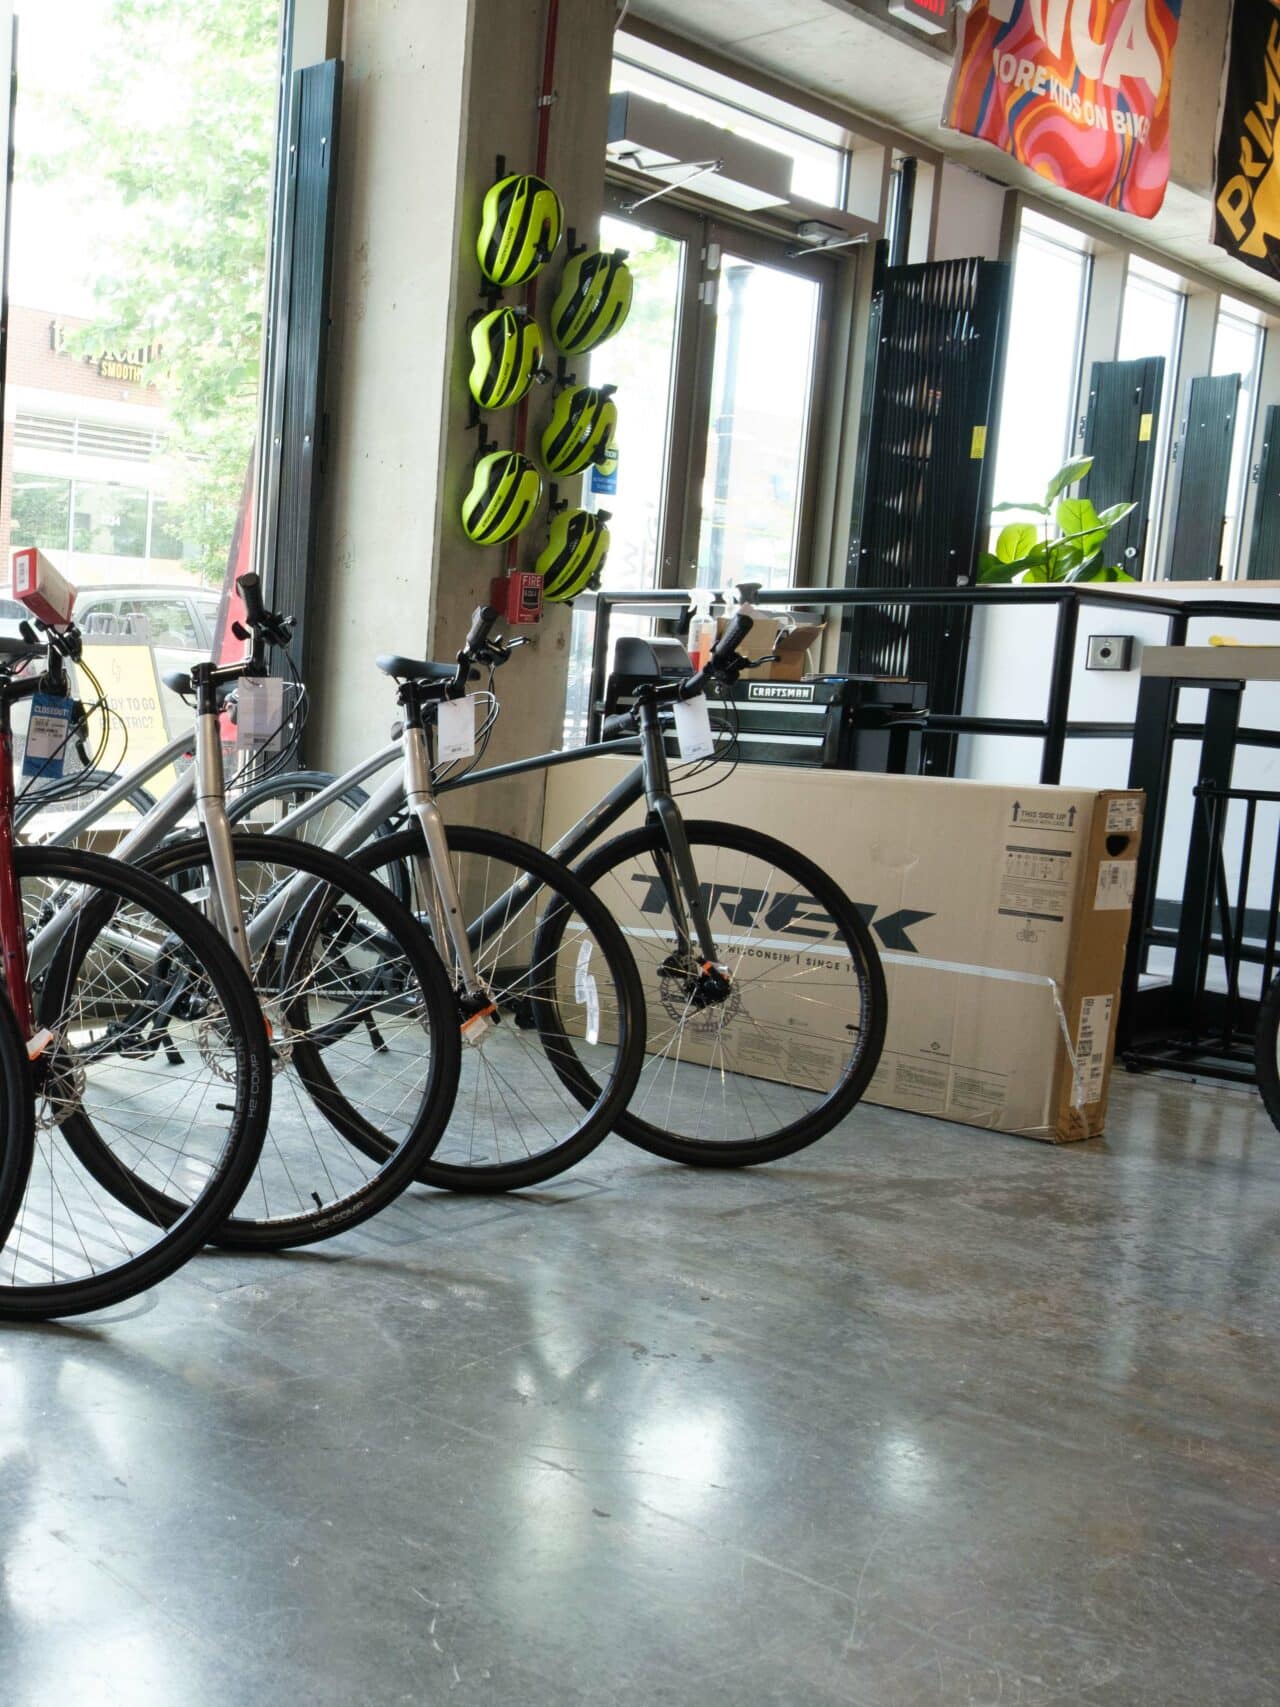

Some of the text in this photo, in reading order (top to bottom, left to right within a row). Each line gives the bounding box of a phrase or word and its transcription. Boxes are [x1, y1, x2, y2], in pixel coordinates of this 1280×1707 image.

[1049, 74, 1080, 120] KIDS
[1083, 101, 1108, 131] ON
[101, 361, 141, 384] SMOOTH
[523, 576, 542, 587] FIRE
[128, 697, 140, 711] TO
[142, 697, 156, 711] GO
[752, 687, 810, 698] CRAFTSMAN
[1021, 809, 1067, 821] THIS SIDE UP
[630, 872, 937, 953] TREK
[728, 947, 791, 962] WISCONSIN
[806, 957, 841, 970] SINCE
[248, 1053, 261, 1118] H2 COMP
